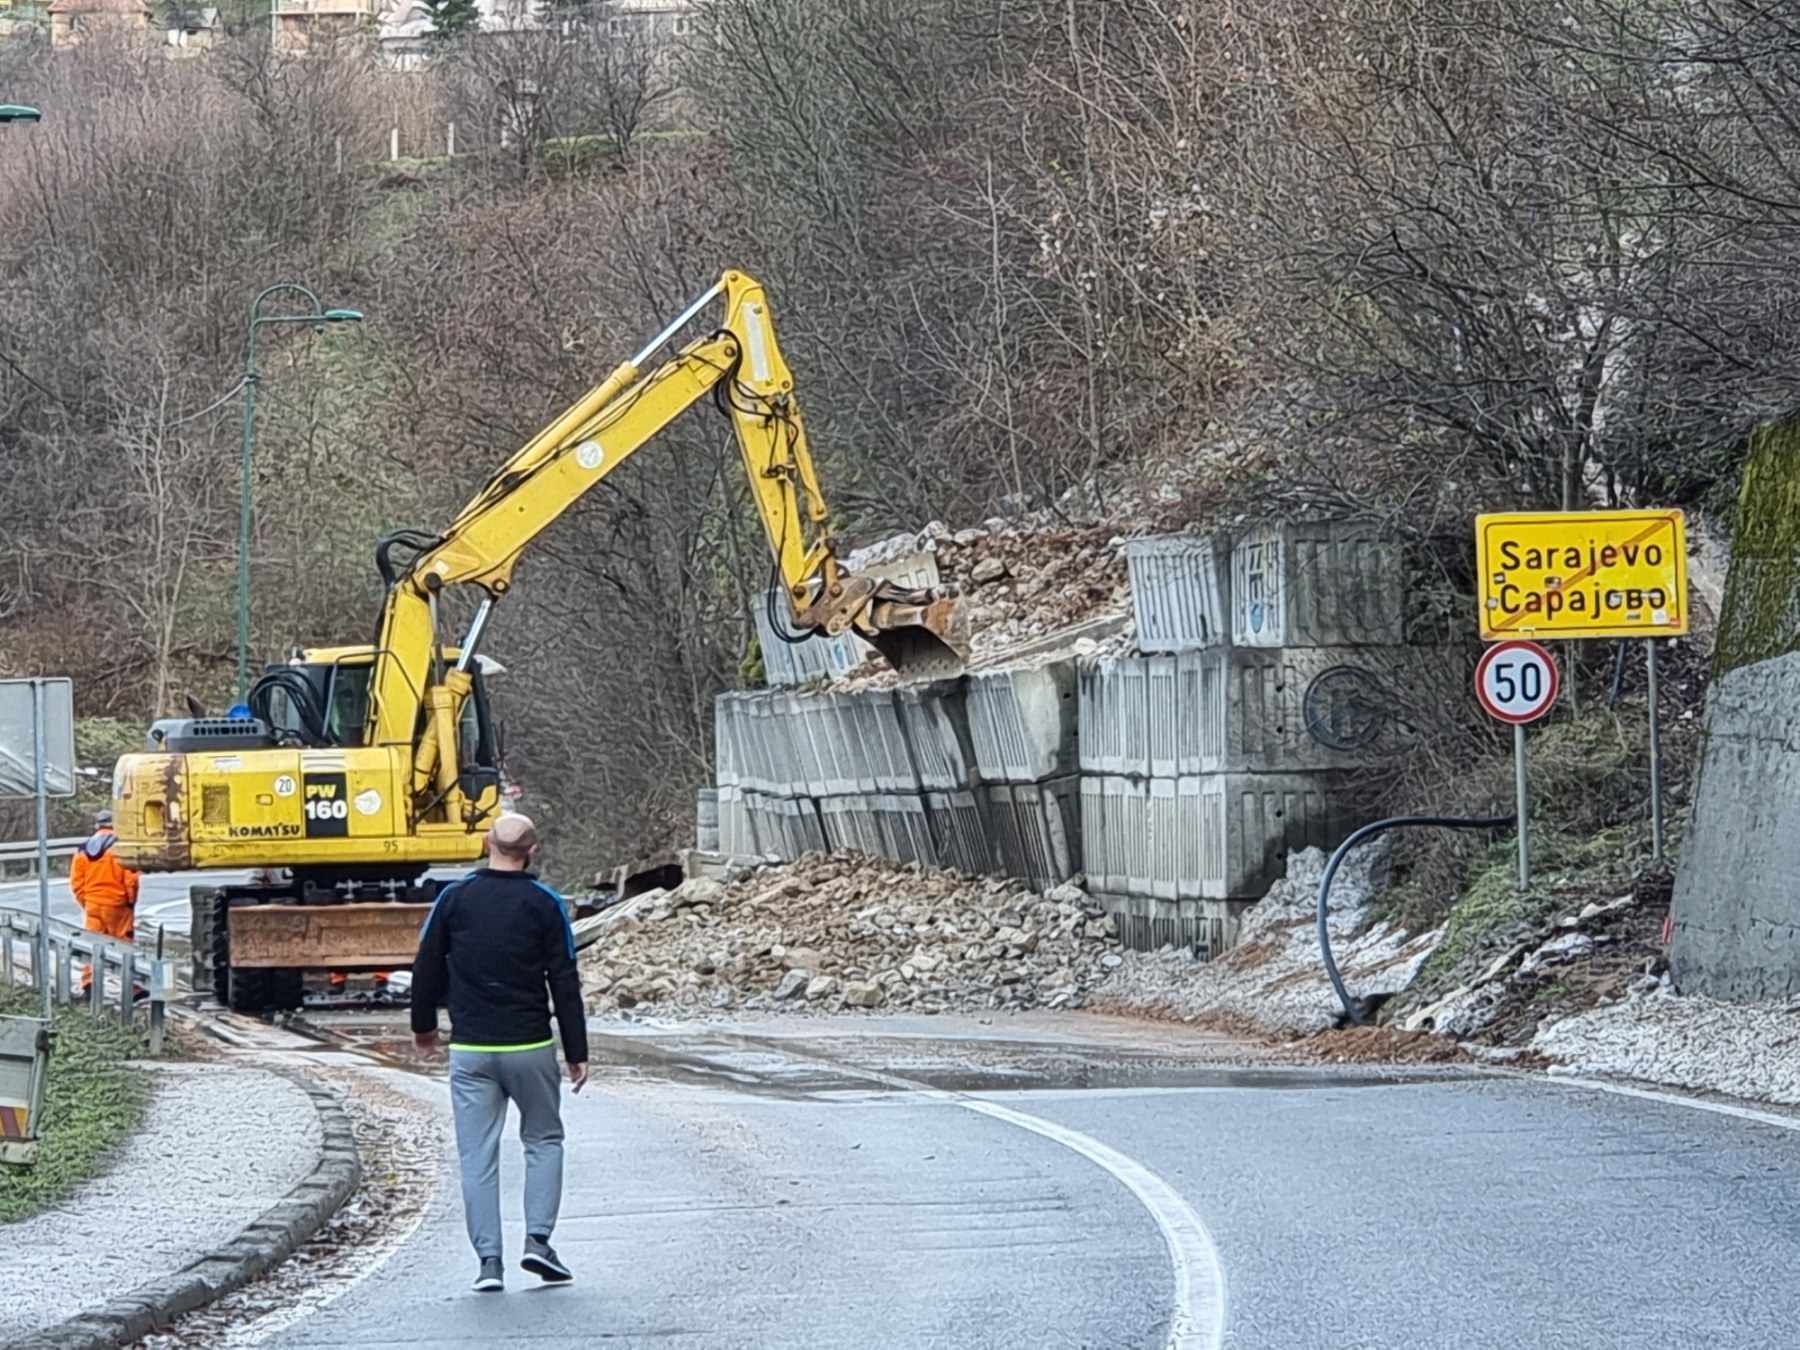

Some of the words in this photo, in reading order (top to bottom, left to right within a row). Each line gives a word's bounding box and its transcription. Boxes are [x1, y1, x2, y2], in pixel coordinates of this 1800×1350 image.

[1500, 540, 1662, 576] Sarajevo
[1495, 662, 1541, 703] 50
[278, 779, 292, 793] 20
[305, 785, 336, 799] PW
[305, 800, 347, 820] 160
[229, 823, 300, 838] KOMATSU
[383, 840, 399, 853] 95
